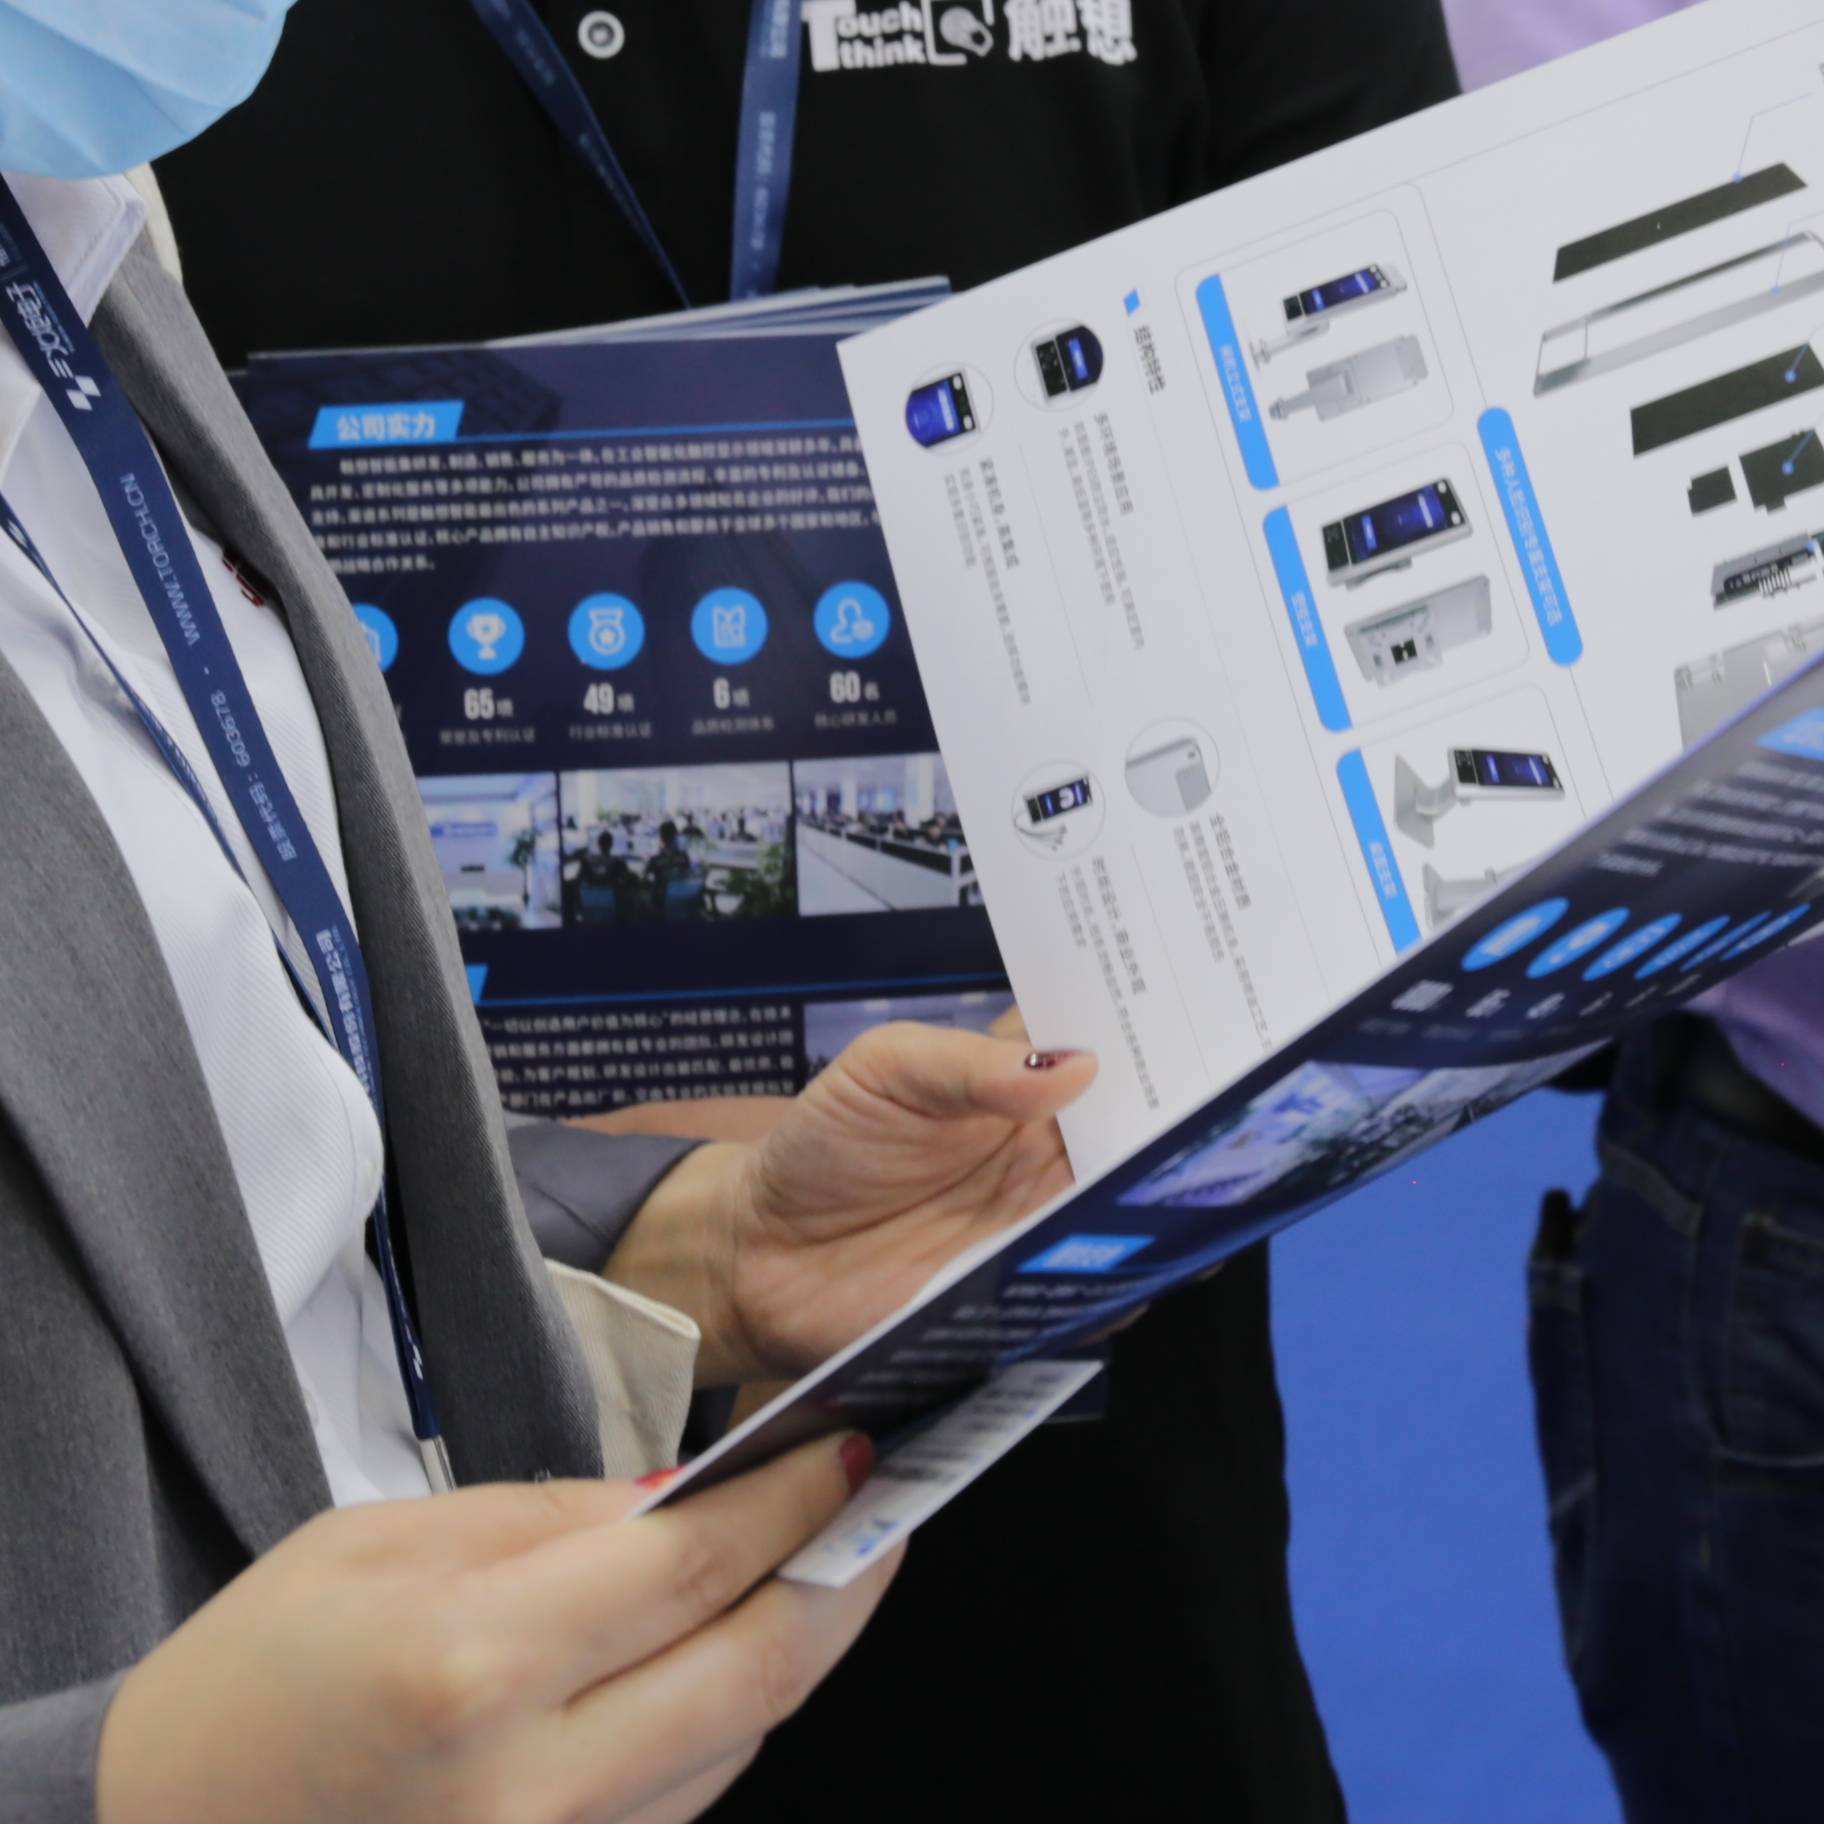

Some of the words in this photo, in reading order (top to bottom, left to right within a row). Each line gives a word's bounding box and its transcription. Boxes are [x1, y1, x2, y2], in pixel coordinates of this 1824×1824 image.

[839, 35, 926, 70] think
[1131, 324, 1167, 395] 结构特性
[336, 412, 437, 441] 公司实力
[117, 470, 203, 646] WWW.TORCH.CN
